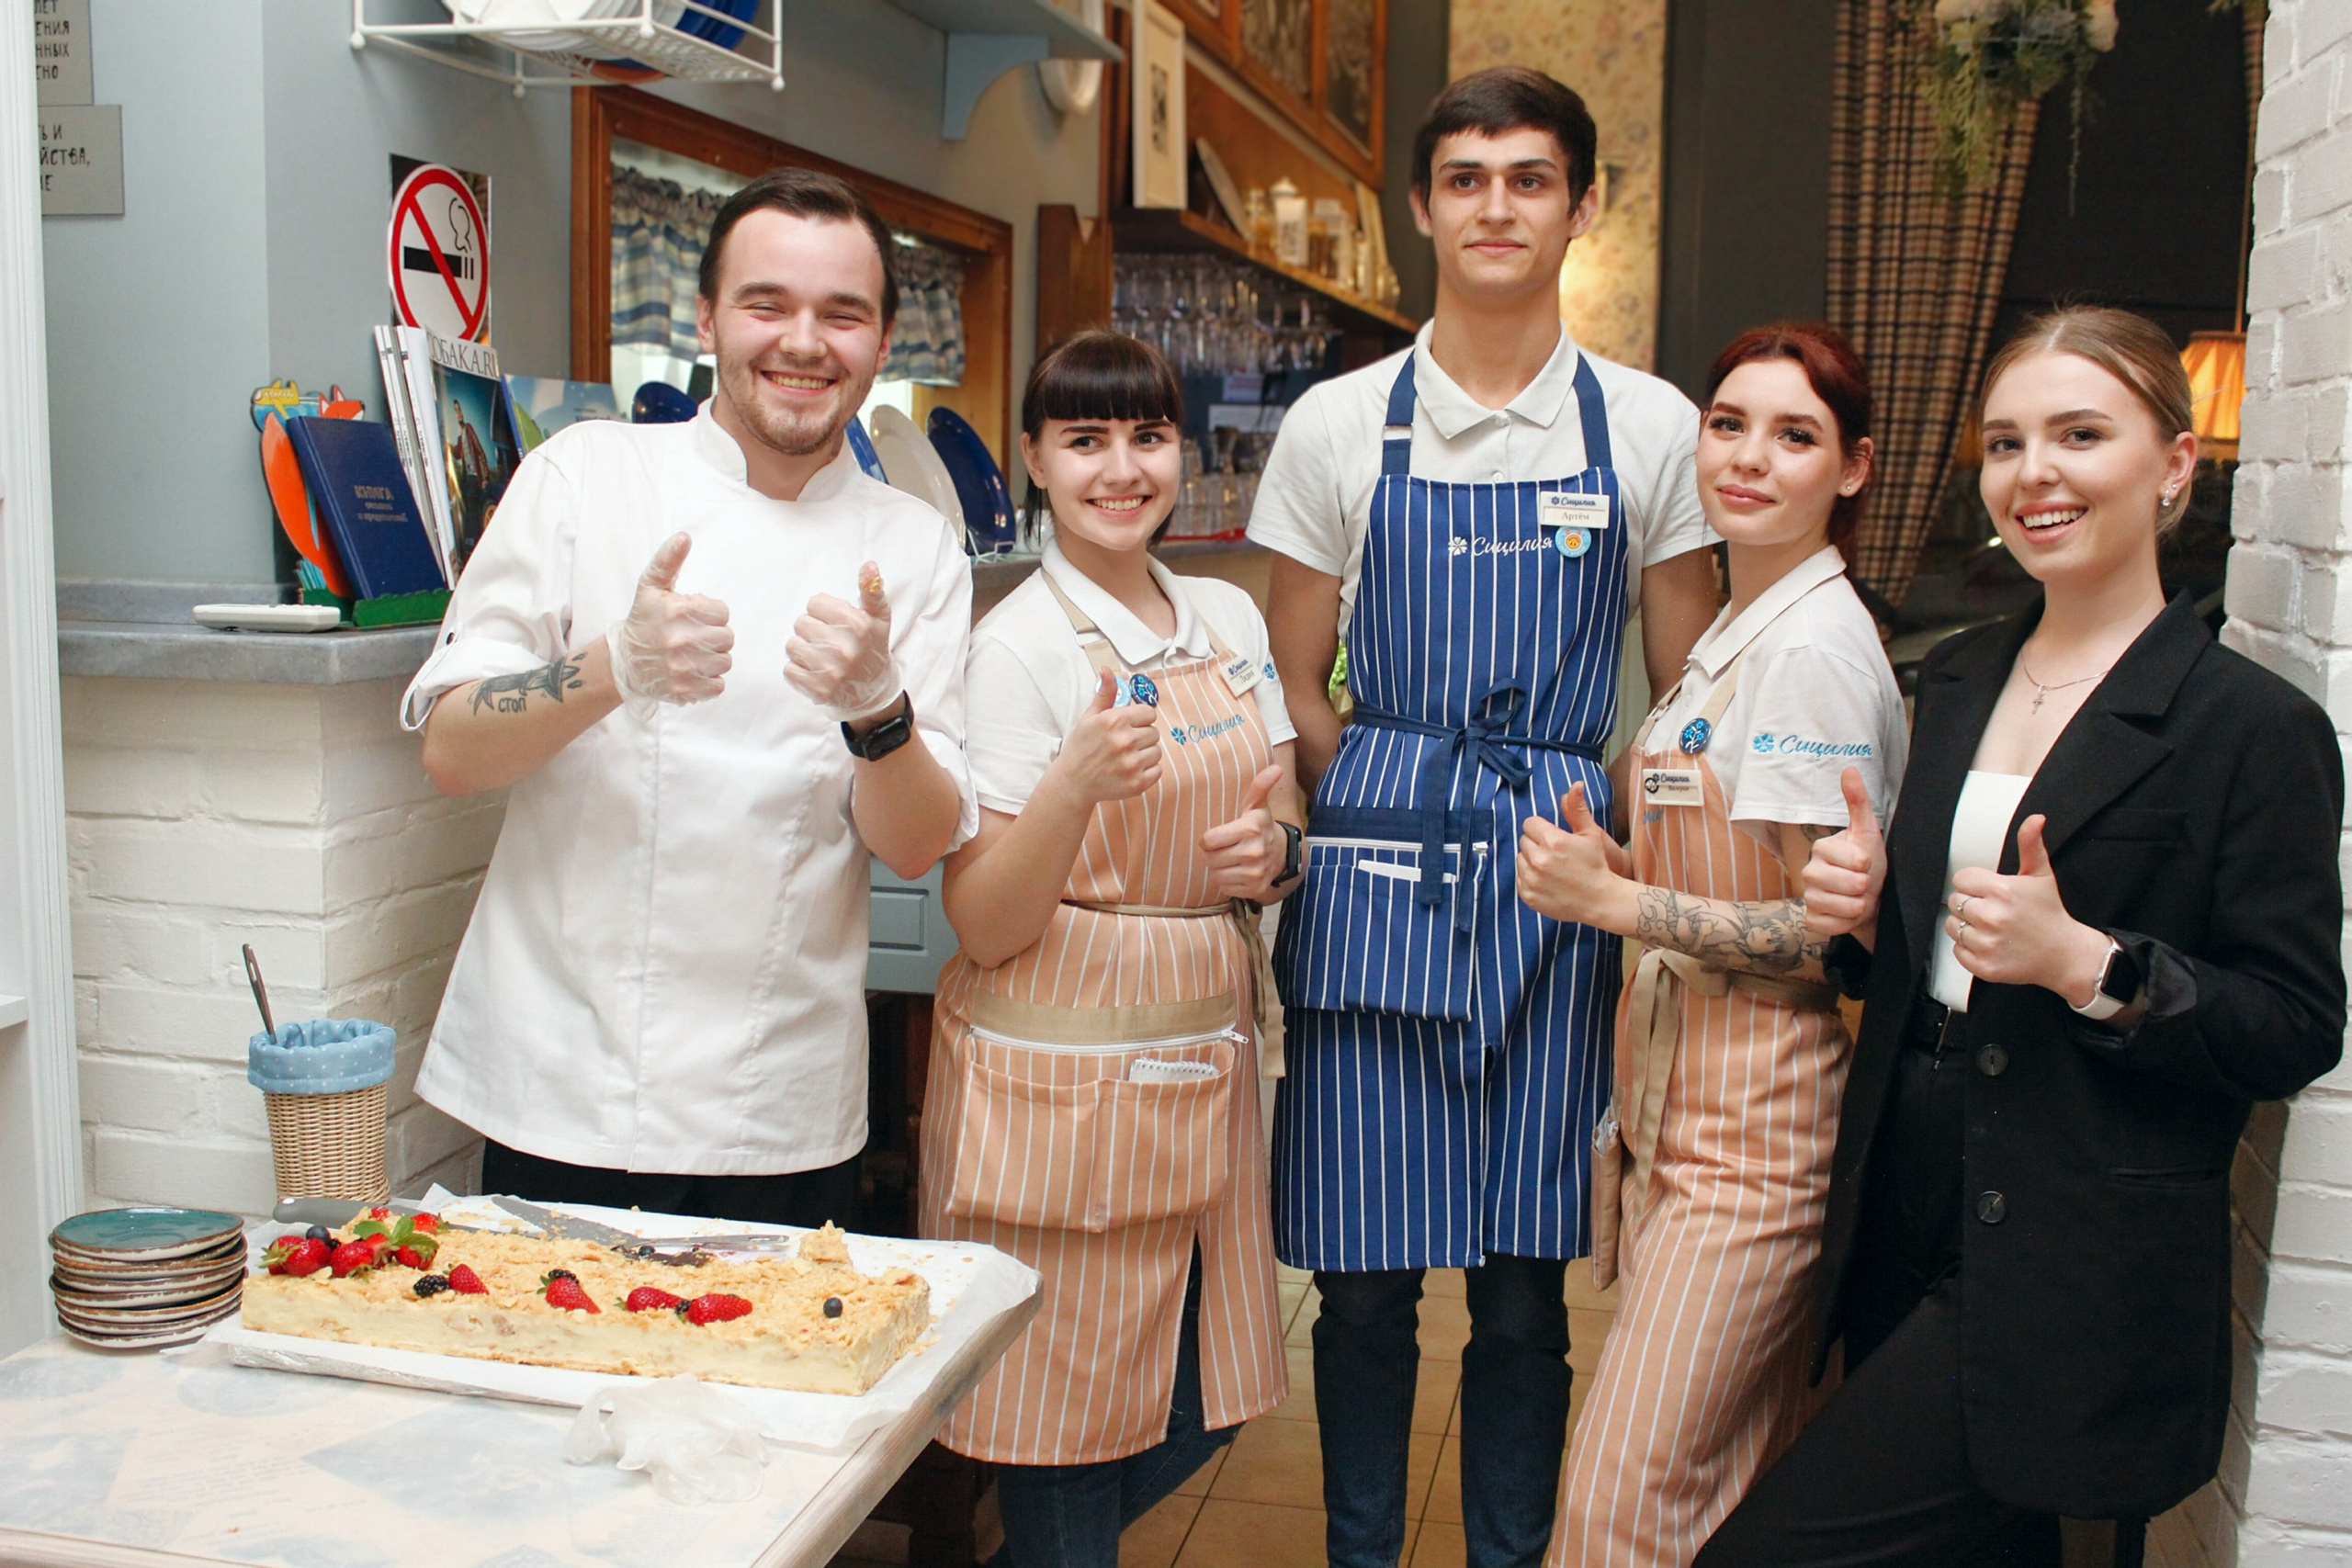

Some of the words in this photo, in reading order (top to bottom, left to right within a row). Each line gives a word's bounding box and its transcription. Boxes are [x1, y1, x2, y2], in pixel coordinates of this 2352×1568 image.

[53, 124, 62, 140] И
[1561, 496, 1597, 506] Сицилия
[1562, 511, 1590, 522] Артём
[1472, 536, 1553, 557] Сицилия
[1188, 714, 1245, 743] Сицилия
[1779, 734, 1872, 758] Сицилия
